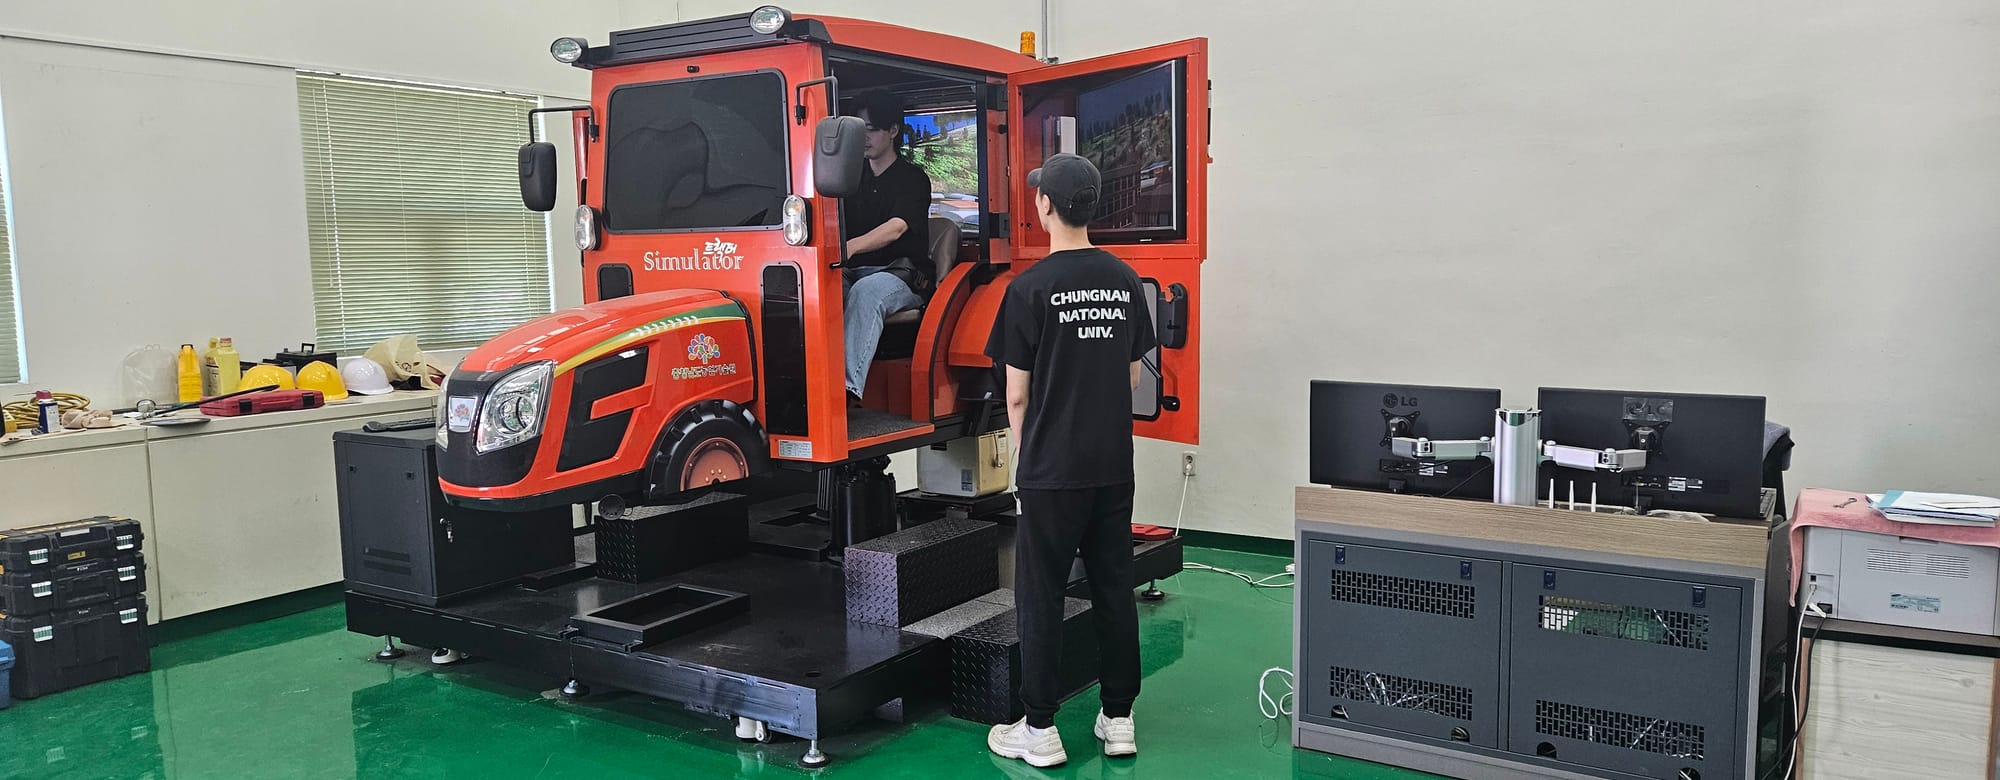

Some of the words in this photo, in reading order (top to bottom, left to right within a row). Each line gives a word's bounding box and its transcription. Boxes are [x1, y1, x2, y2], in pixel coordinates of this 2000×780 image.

[643, 247, 744, 271] Simulator
[1050, 289, 1130, 306] CHUNGNAM
[1058, 307, 1127, 324] NATONA
[1078, 326, 1114, 339] UNIV.
